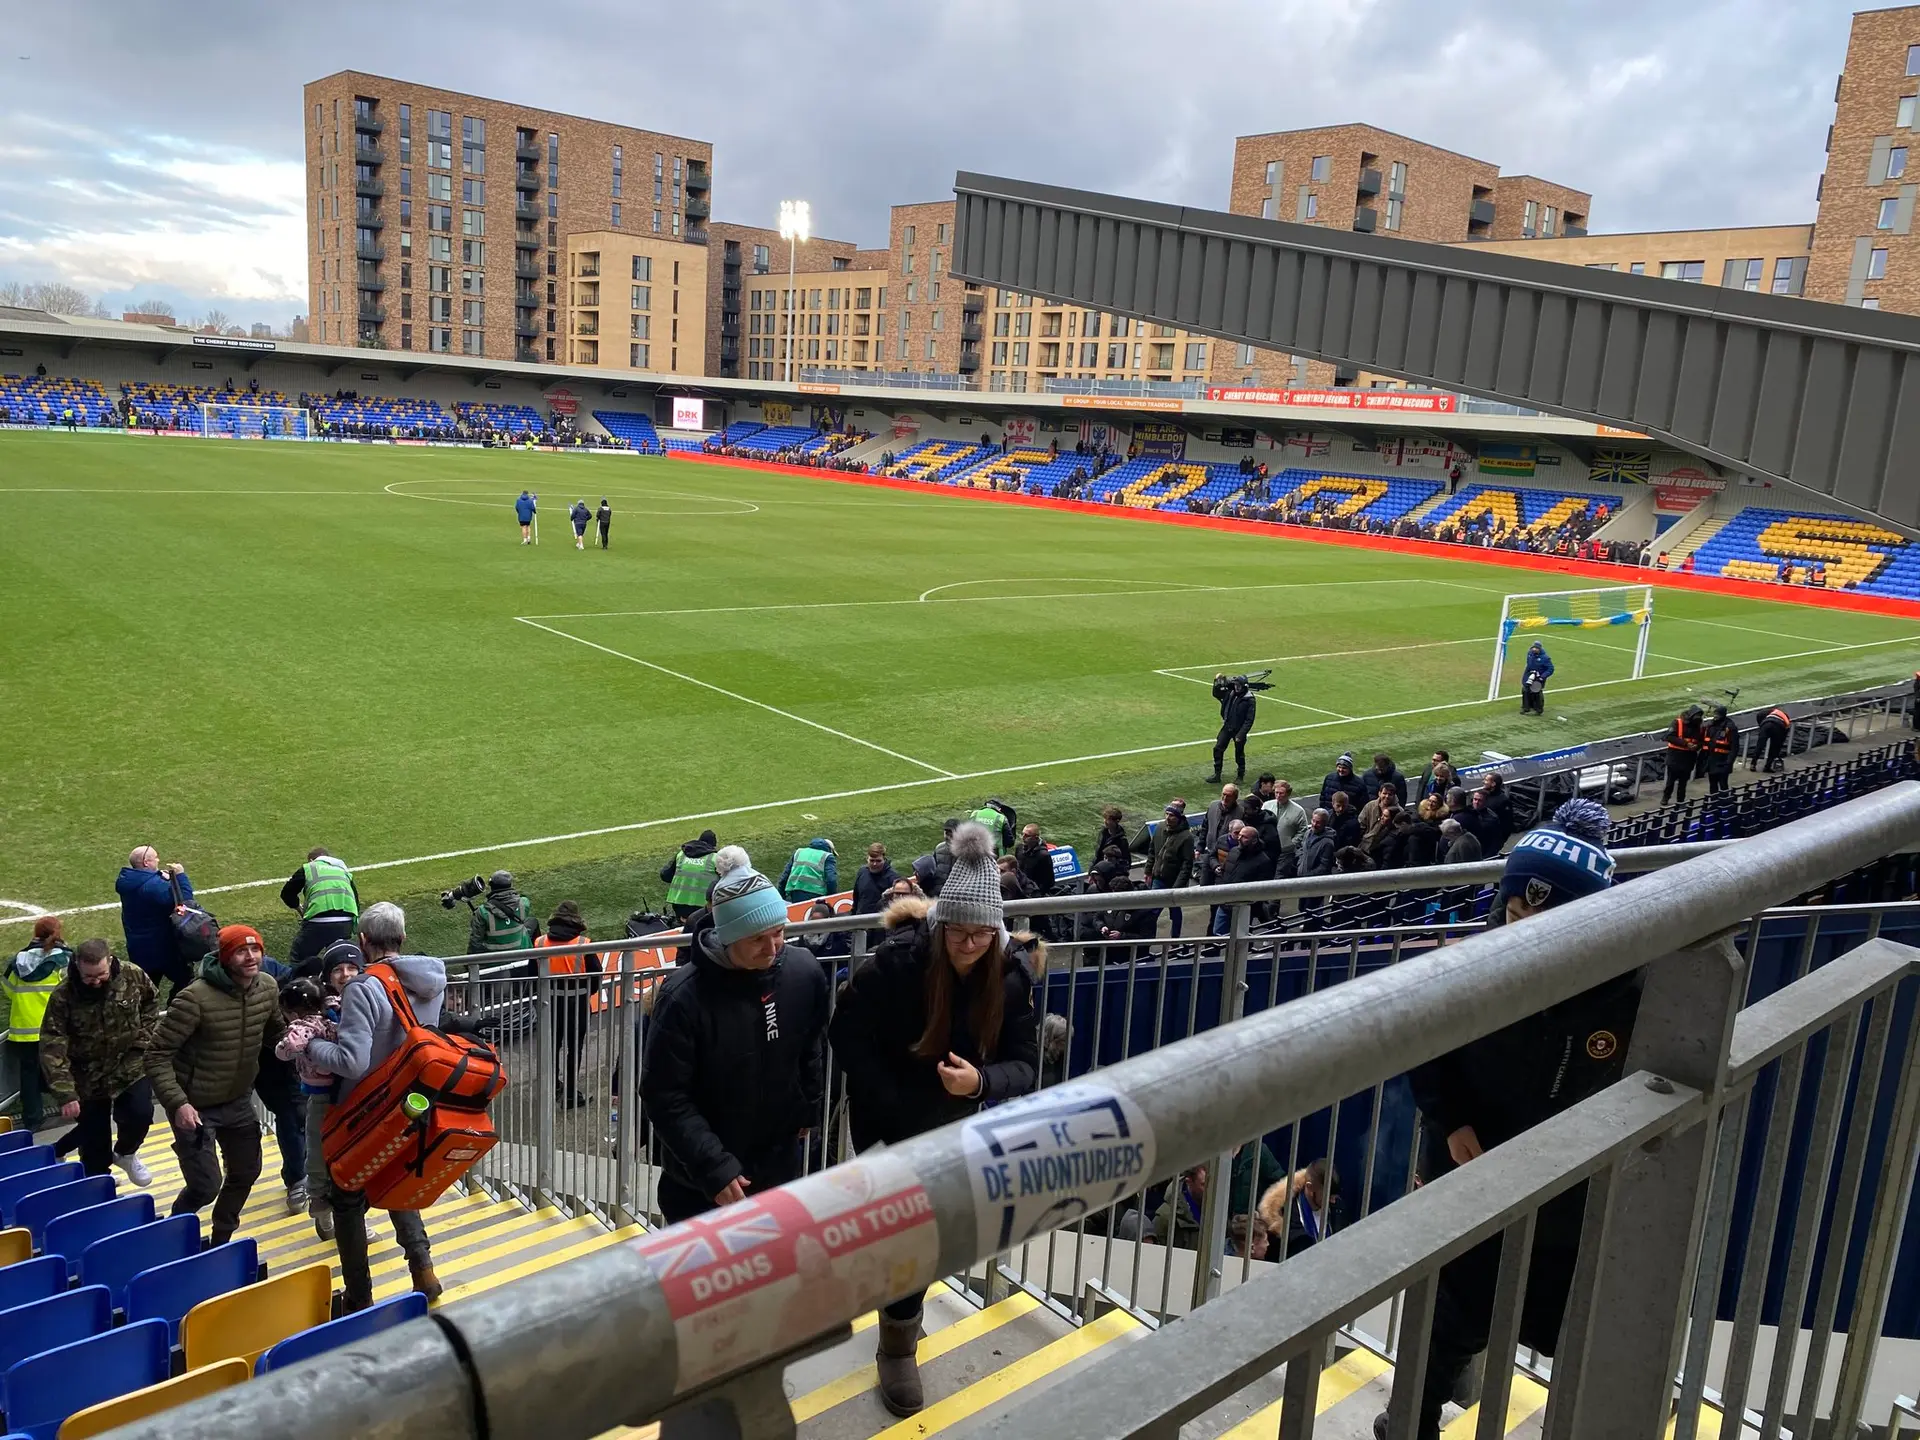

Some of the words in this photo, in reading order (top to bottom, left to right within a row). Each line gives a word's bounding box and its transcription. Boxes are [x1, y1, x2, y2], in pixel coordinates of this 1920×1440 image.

[1224, 391, 1245, 400] CHERRY
[1245, 392, 1256, 400] RED
[1366, 396, 1390, 406] CHERRY
[1390, 397, 1403, 406] RED
[1403, 398, 1434, 408] RECORDS
[677, 410, 698, 419] DRK
[1144, 424, 1157, 433] WE
[1160, 424, 1177, 433] ARE
[1134, 431, 1185, 442] WIMBLEDON
[1648, 475, 1675, 486] CHERRY
[1676, 477, 1691, 487] RED
[1691, 478, 1727, 490] RECORDS
[684, 857, 704, 866] PRESS
[764, 1002, 779, 1041] NIKE
[1050, 1121, 1077, 1148] FC
[981, 1163, 1015, 1200] DE
[1019, 1142, 1144, 1197] AVONTURIERS
[822, 1218, 863, 1249] ON
[863, 1192, 933, 1225] TOUR
[690, 1252, 773, 1301] DONS
